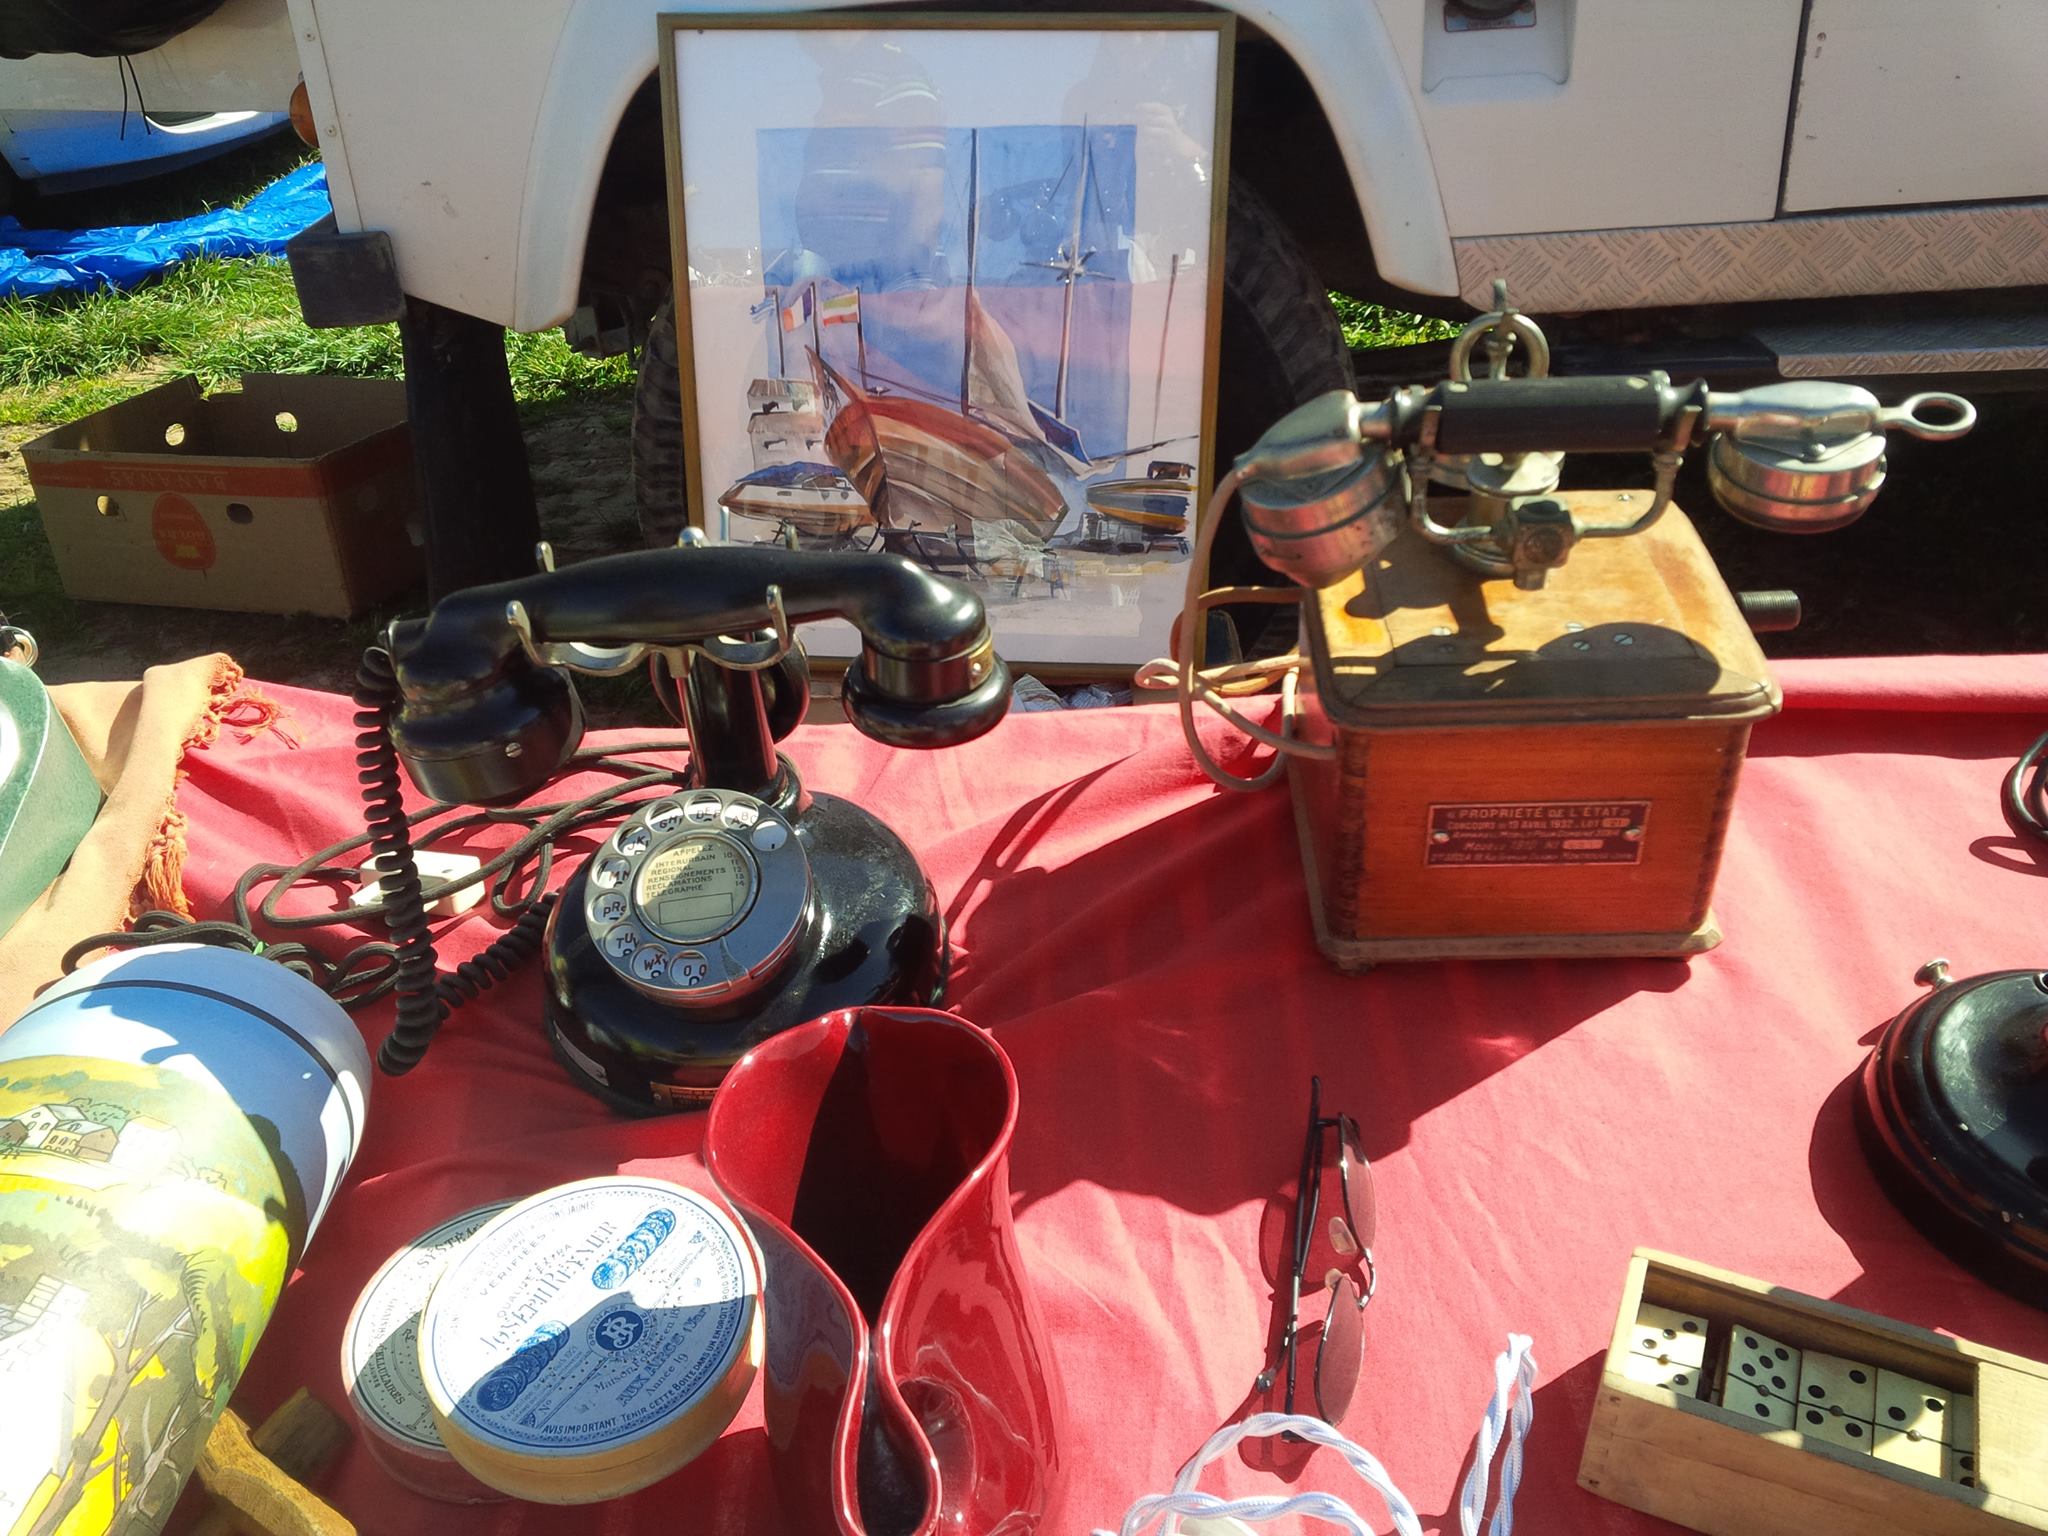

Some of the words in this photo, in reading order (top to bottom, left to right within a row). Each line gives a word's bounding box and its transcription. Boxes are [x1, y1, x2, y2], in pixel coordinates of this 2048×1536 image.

[110, 471, 226, 489] BANANAS
[1548, 808, 1564, 817] DE
[656, 854, 716, 868] INTERURBAIN
[646, 875, 713, 891] RECLAMATIONS
[647, 867, 726, 884] RENSEIGNEMENTS
[648, 1389, 675, 1410] CETTE
